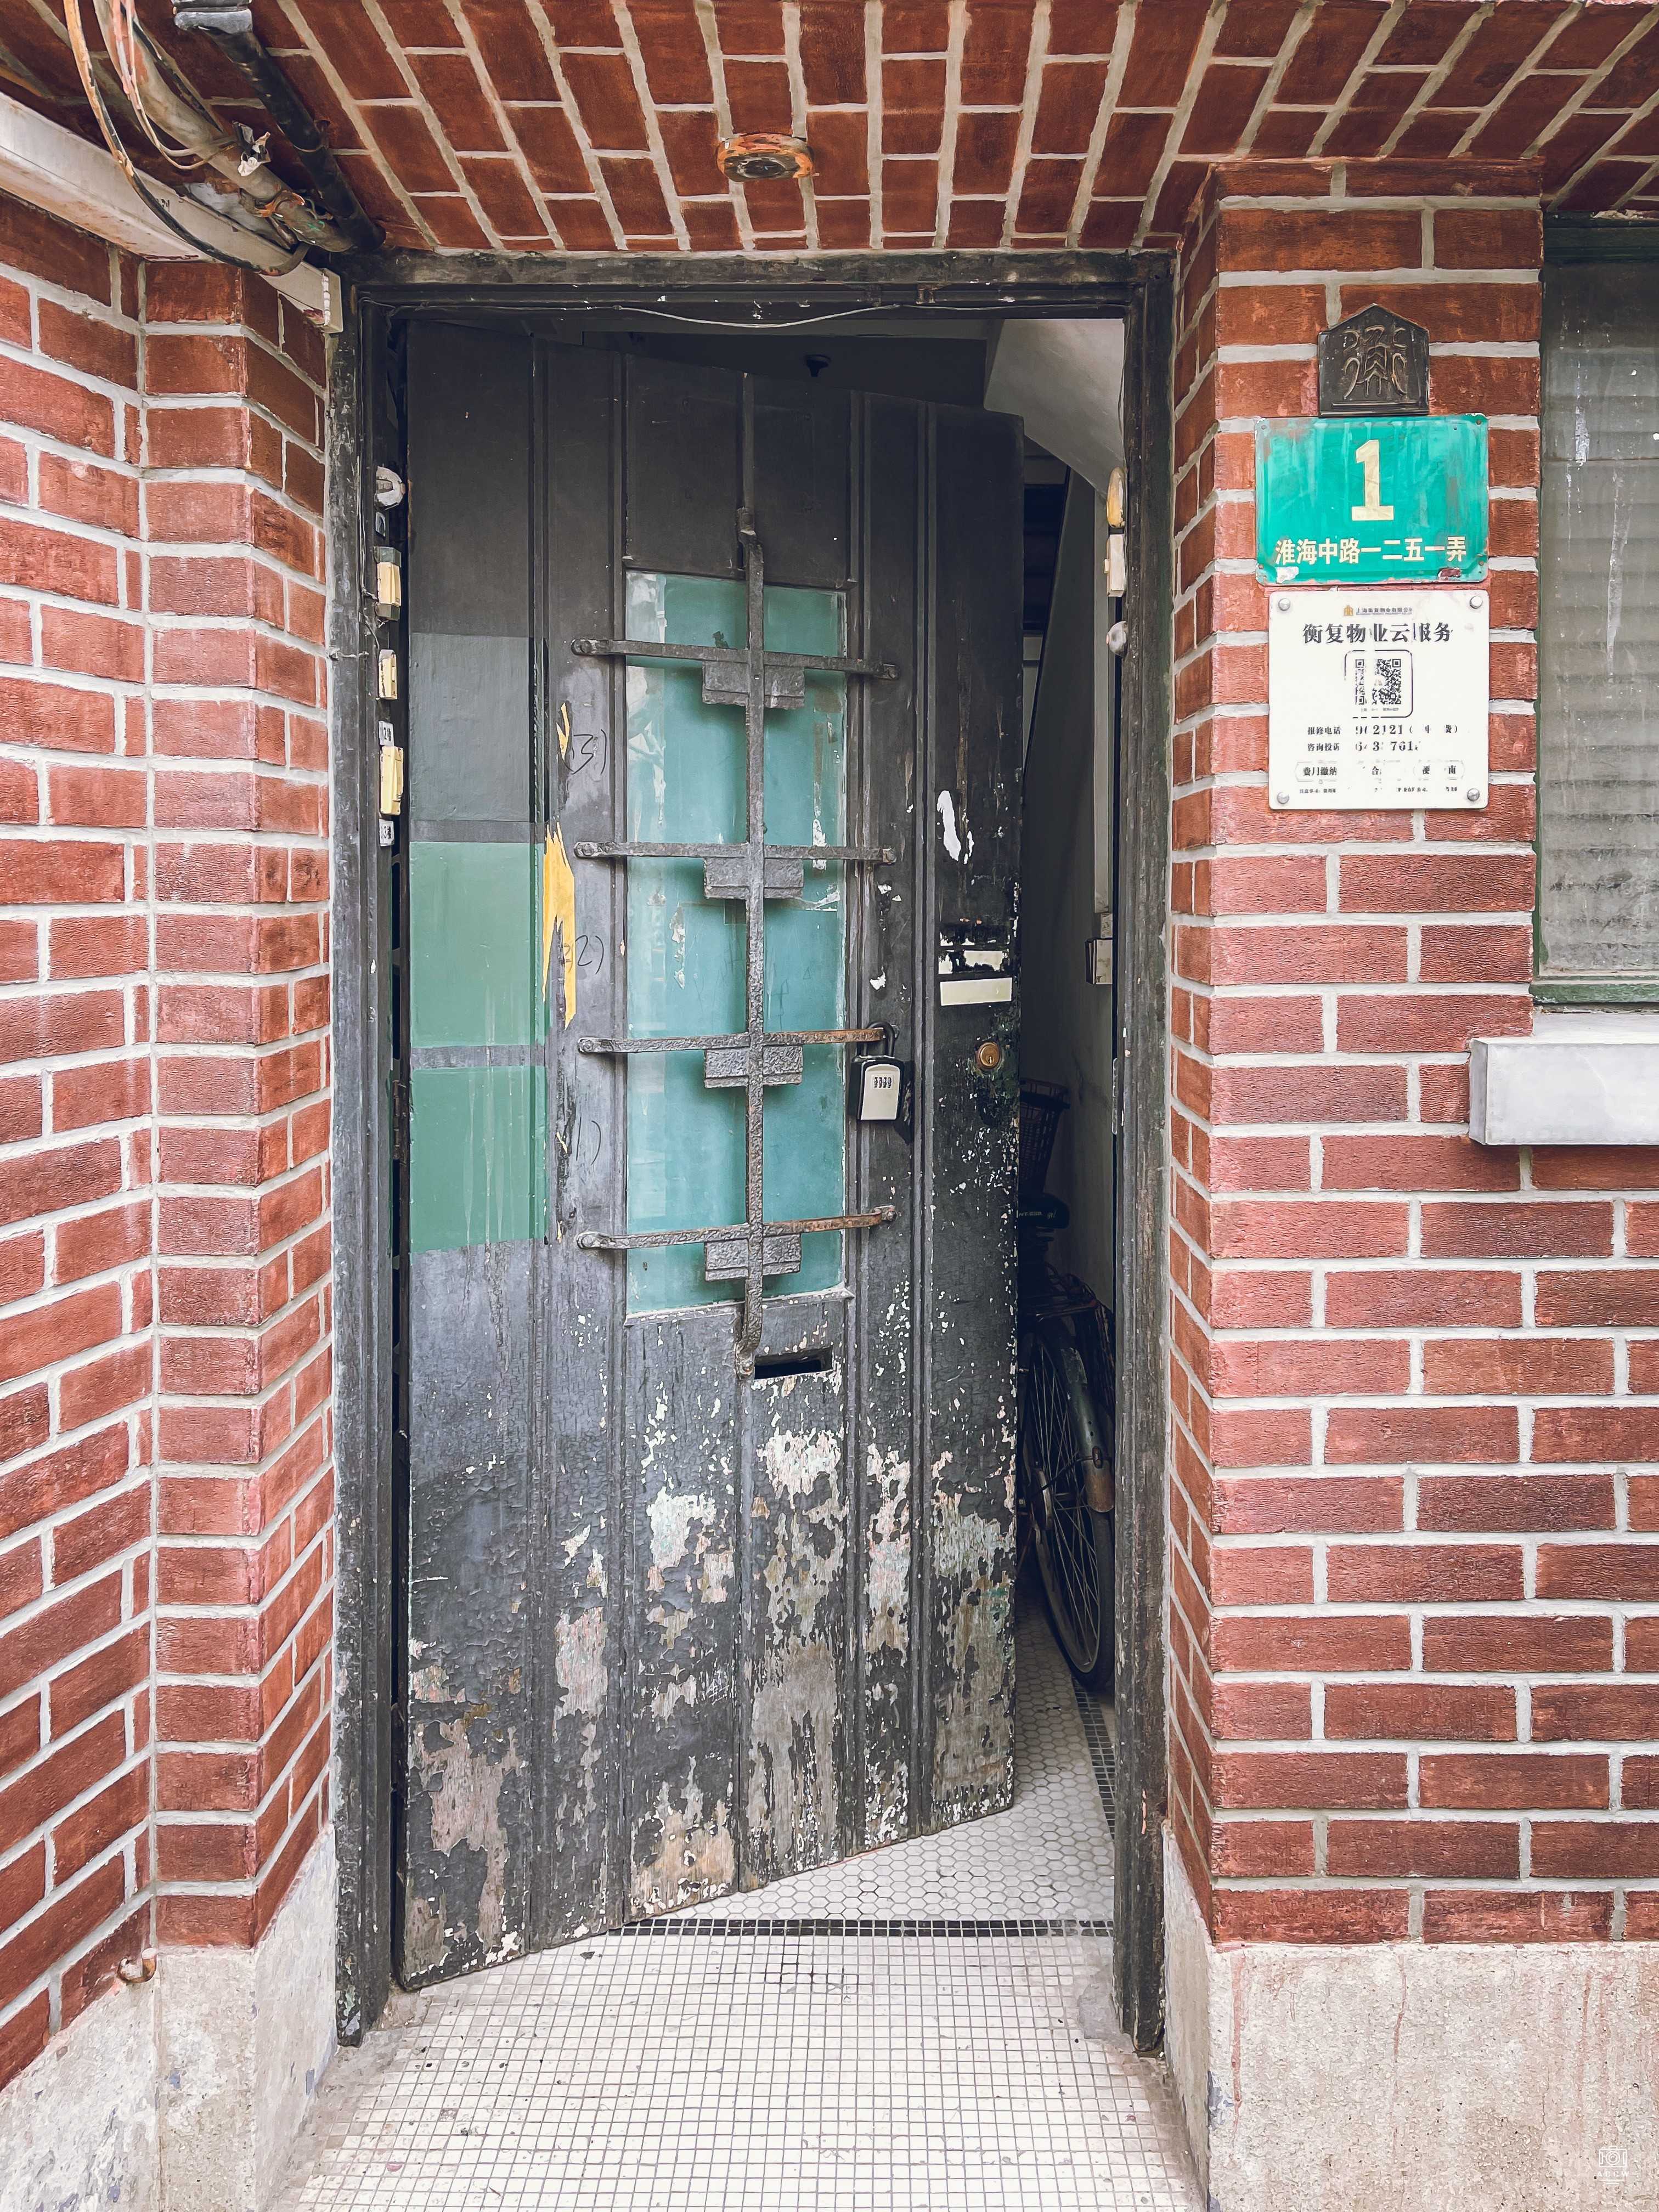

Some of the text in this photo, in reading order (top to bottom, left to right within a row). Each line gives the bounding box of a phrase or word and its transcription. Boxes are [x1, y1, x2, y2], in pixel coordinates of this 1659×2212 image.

[1351, 439, 1394, 521] 1
[1275, 536, 1466, 565] 淮海中路一二五一弄
[1302, 622, 1452, 644] 衡复物业云服务
[1307, 726, 1341, 735] 报修电话
[1307, 742, 1339, 751] 咨询投诉
